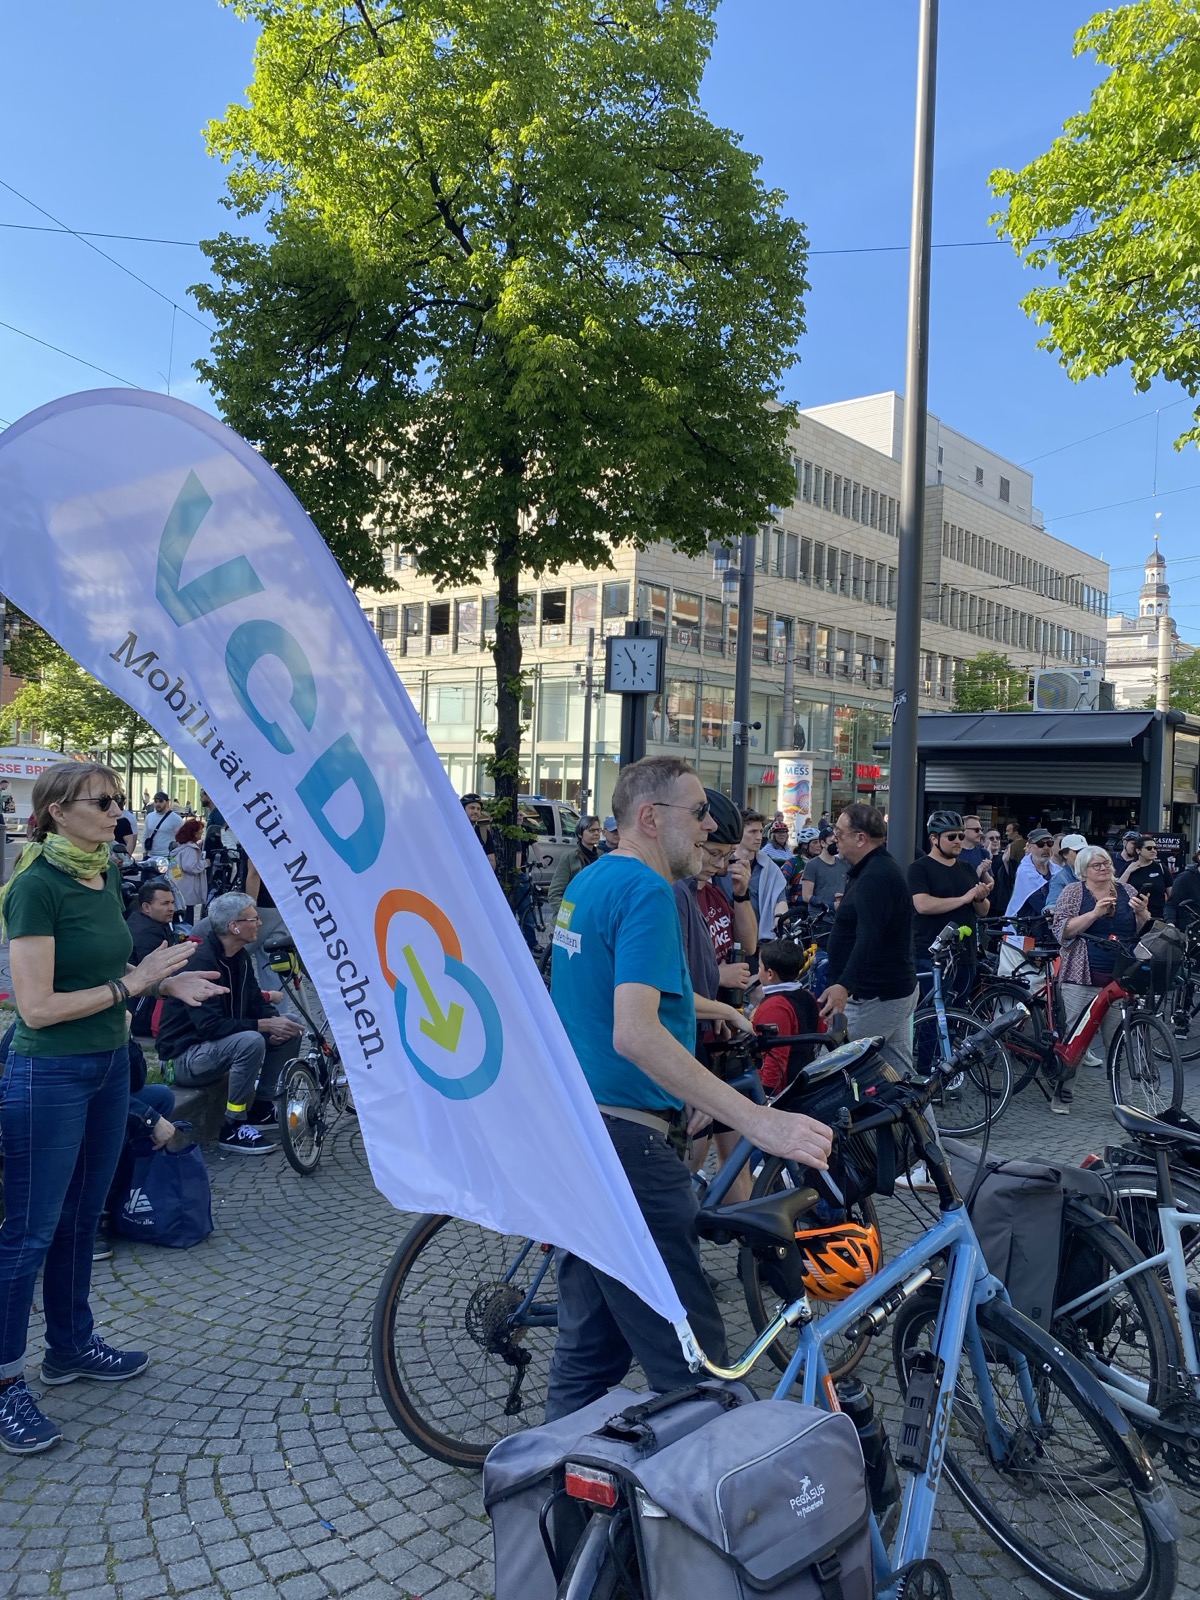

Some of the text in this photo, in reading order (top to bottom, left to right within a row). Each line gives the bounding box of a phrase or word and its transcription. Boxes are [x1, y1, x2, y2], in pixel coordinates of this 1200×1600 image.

[156, 469, 386, 874] VCD
[784, 766, 809, 776] MESS
[856, 763, 881, 779] HEMA
[108, 631, 386, 1071] Mobilität für Menschen.
[789, 1484, 826, 1510] PEGASUS
